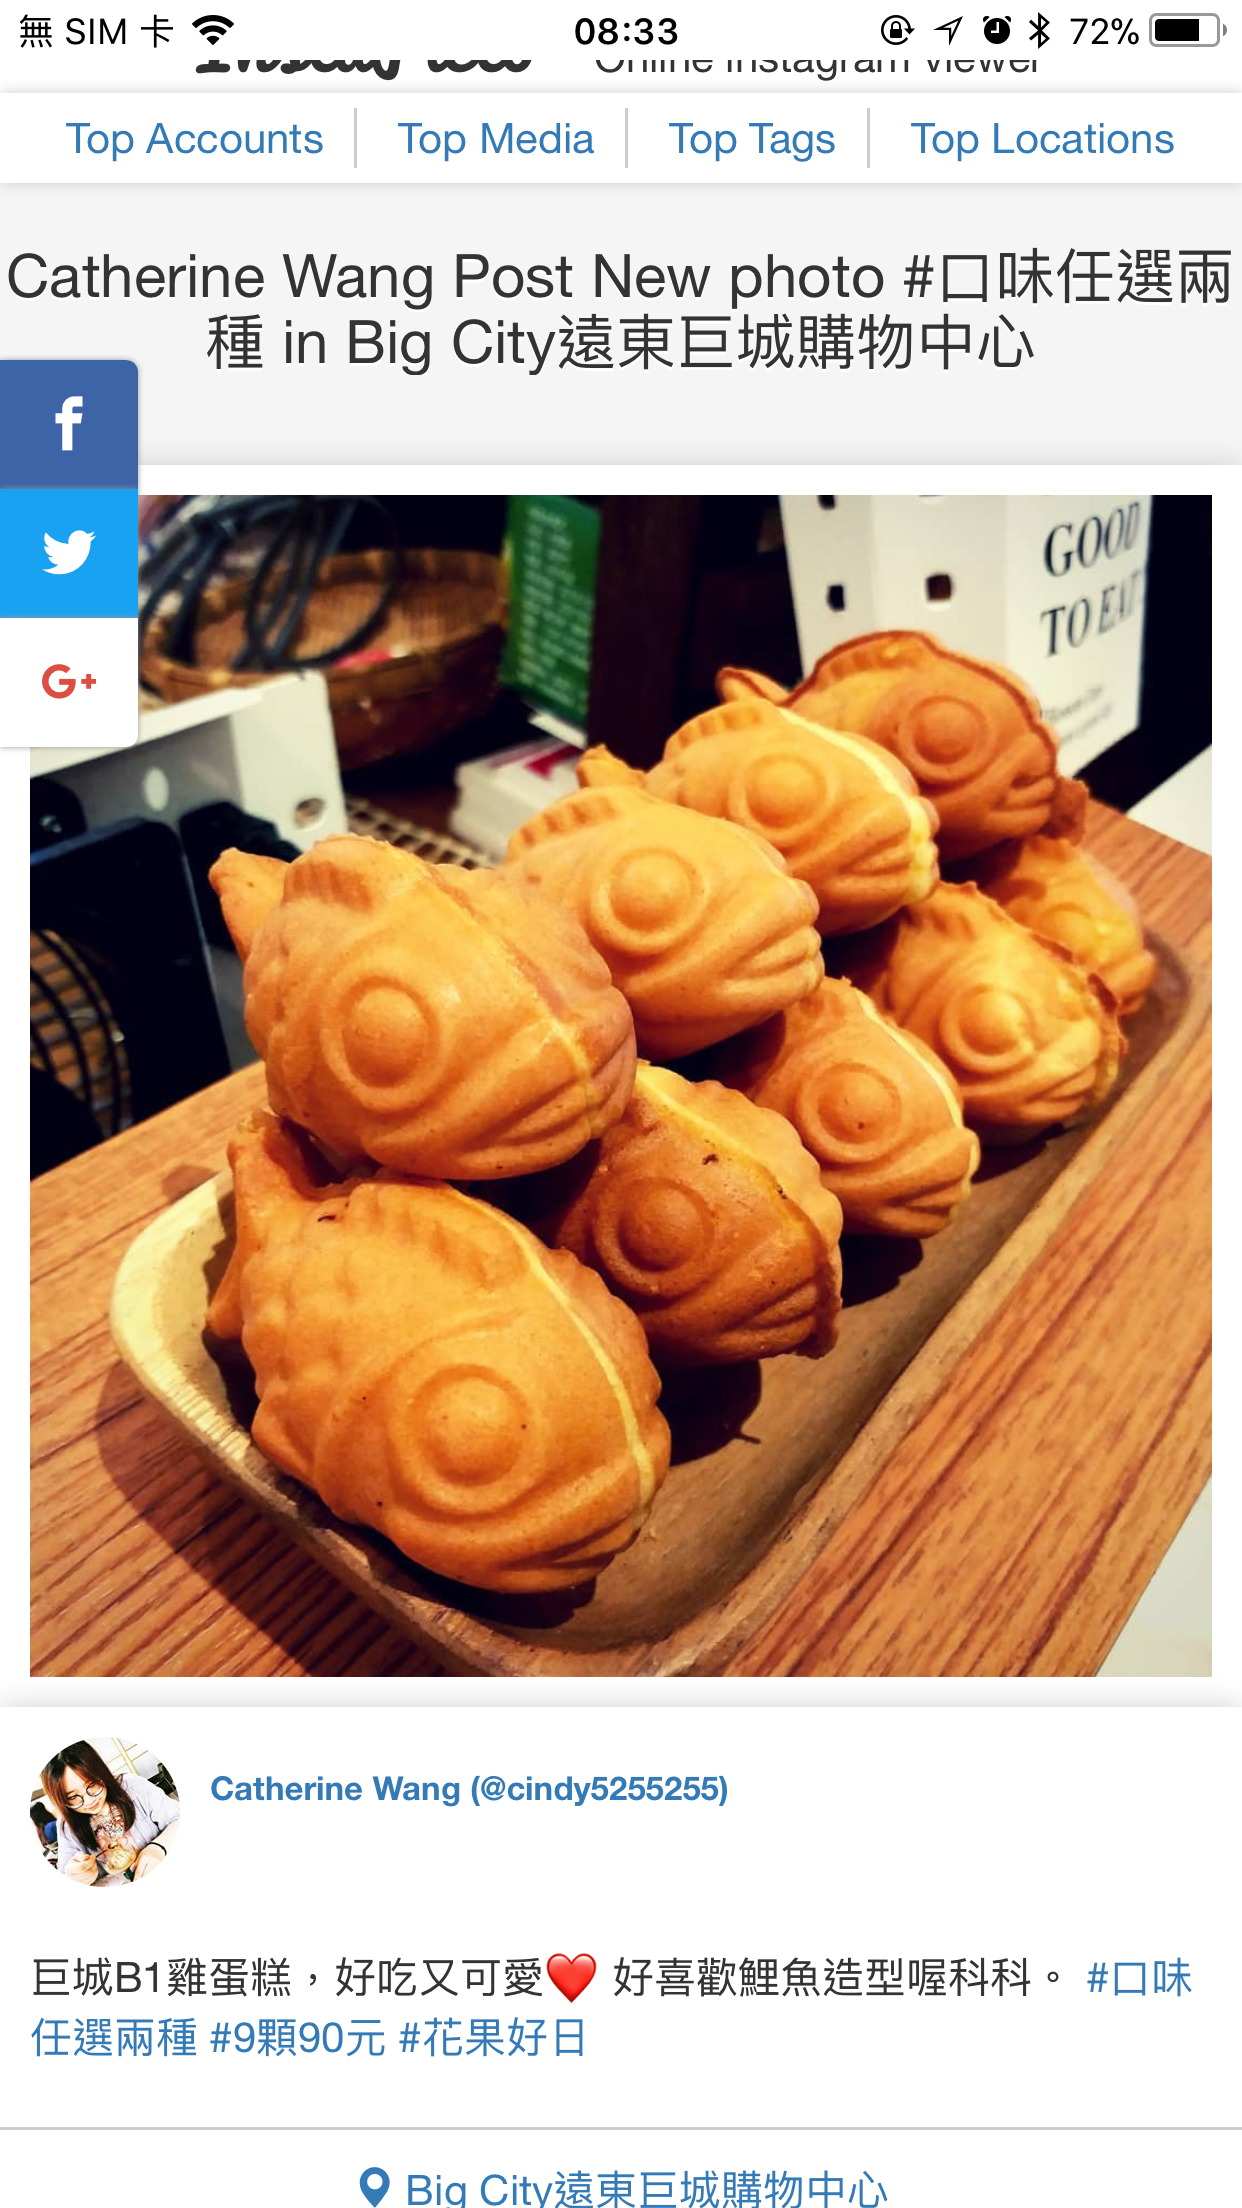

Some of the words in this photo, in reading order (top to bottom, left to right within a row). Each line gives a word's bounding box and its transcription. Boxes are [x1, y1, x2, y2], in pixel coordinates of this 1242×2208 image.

[20, 14, 52, 48] 無
[66, 18, 127, 45] SIM
[141, 14, 174, 48] 卡
[575, 18, 679, 45] 08:33
[1070, 18, 1140, 45] 72%
[66, 123, 135, 162] Top
[146, 122, 323, 155] Accounts
[398, 123, 467, 162] Top
[482, 122, 594, 155] Media
[669, 123, 738, 162] Top
[749, 123, 836, 162] Tags
[911, 123, 980, 162] Top
[994, 122, 1174, 155] Locations
[8, 253, 264, 299] Catherine
[283, 254, 433, 310] Wang
[456, 254, 573, 298] Post
[595, 254, 712, 298] New
[732, 254, 885, 308] photo
[904, 248, 1231, 303] #口味任選兩
[207, 314, 263, 369] 種
[286, 320, 326, 363] in
[349, 320, 431, 375] Big
[453, 313, 1034, 375] City遠東巨城購物中心
[1044, 501, 1140, 577] GOOD
[1040, 598, 1091, 658] TO
[211, 1776, 362, 1801] Catherine
[373, 1776, 460, 1807] Wang
[471, 1776, 728, 1807] (@cindy5255255)
[1087, 1957, 1192, 1997] #口味
[31, 2018, 197, 2057] 任選兩種
[210, 2018, 385, 2057] #9顆90元
[399, 2017, 584, 2057] #花果好日
[408, 2174, 466, 2208] Big
[481, 2170, 888, 2208] City遠東巨城購物中心
